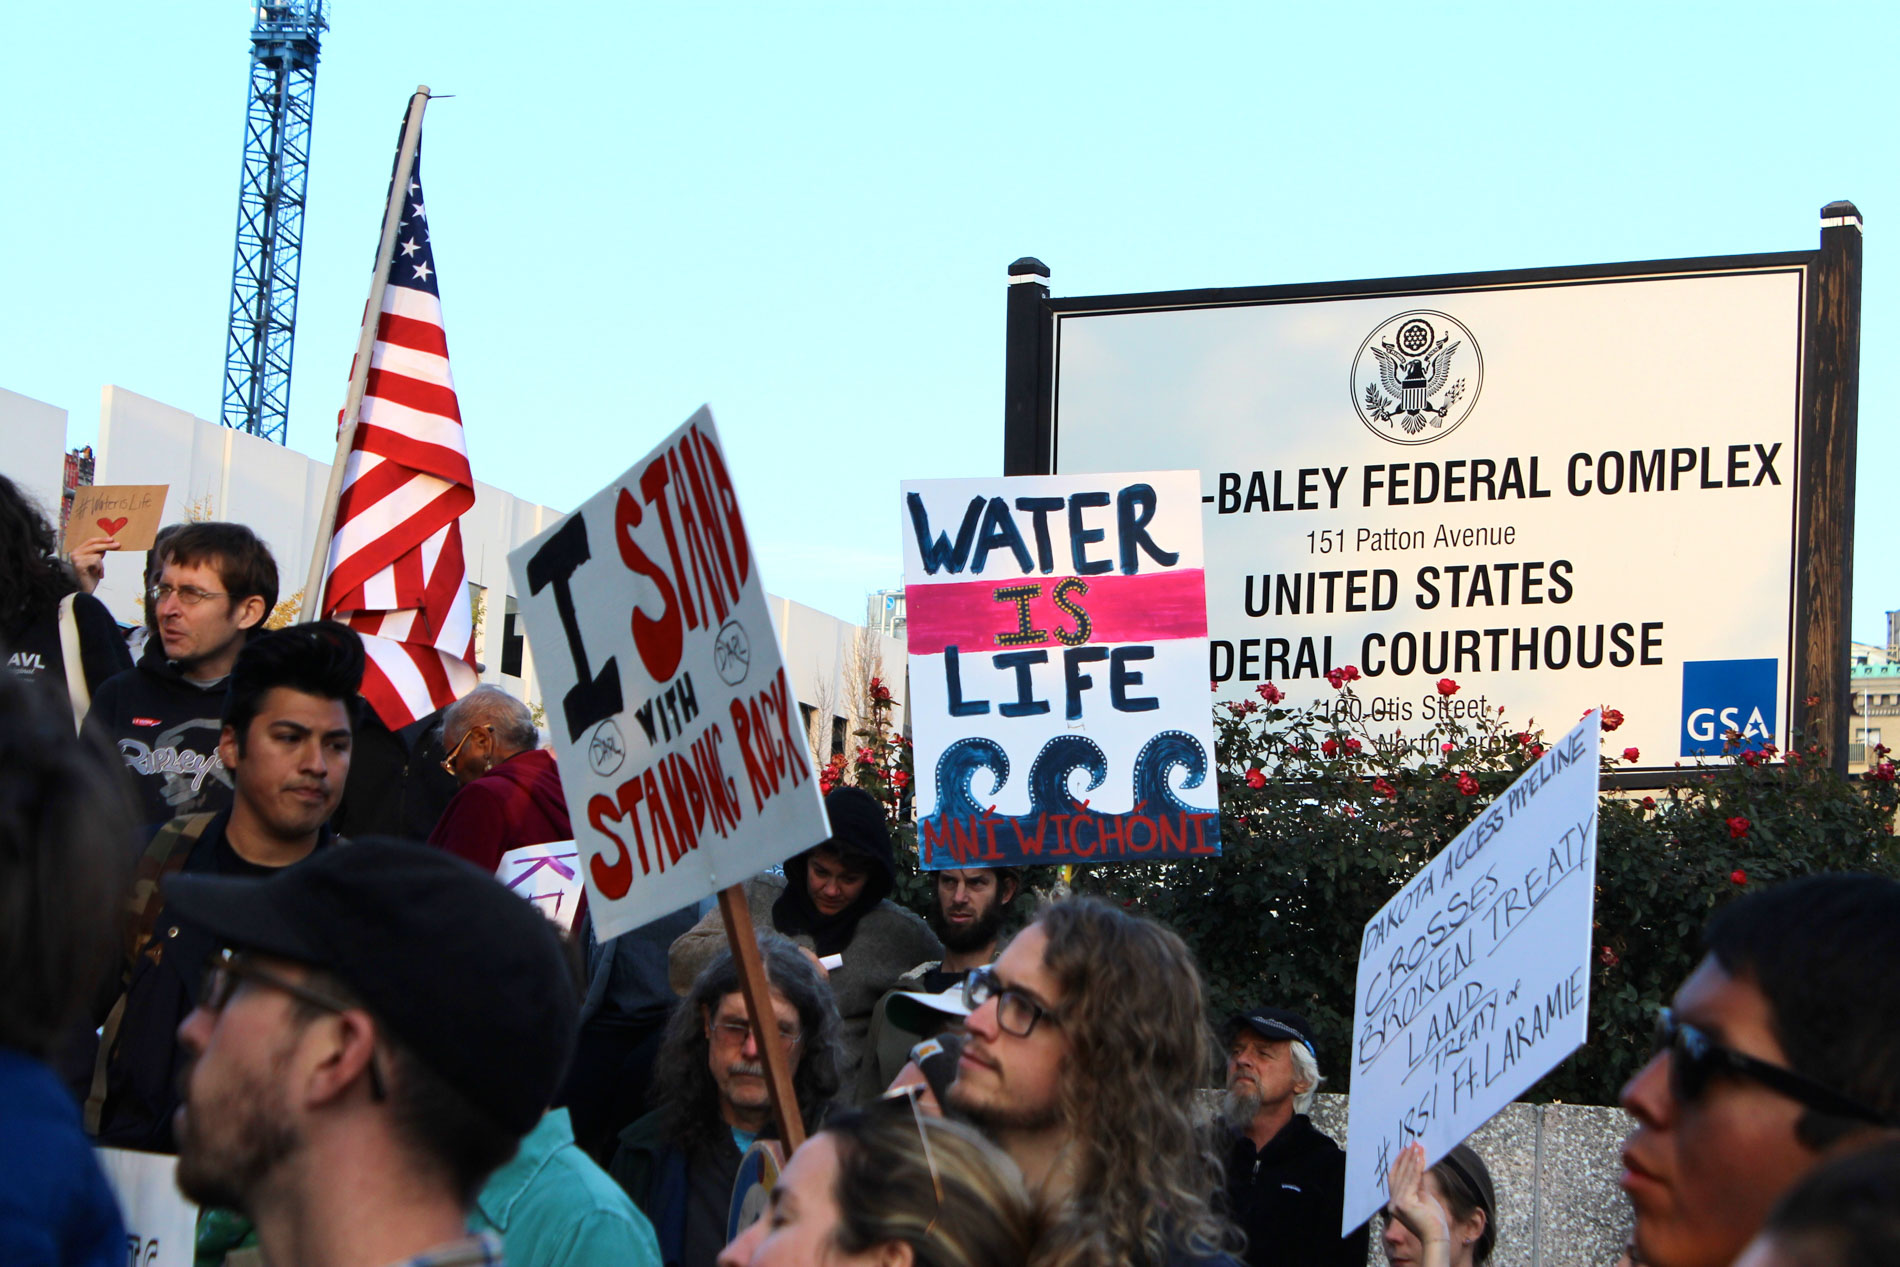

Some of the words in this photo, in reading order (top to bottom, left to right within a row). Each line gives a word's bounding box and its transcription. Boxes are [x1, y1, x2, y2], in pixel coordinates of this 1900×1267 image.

[1363, 456, 1551, 507] FEDERAL
[1567, 443, 1782, 497] COMPLEX
[907, 483, 1179, 575] WATER
[1307, 529, 1345, 554] 151
[1356, 527, 1425, 552] Patton
[1433, 524, 1516, 549] Avenue
[527, 510, 623, 744] I
[615, 422, 749, 683] STAND
[993, 576, 1092, 646] IS
[1244, 568, 1399, 618] UNITED
[1415, 559, 1573, 611] STATES
[7, 652, 46, 669] AVL
[944, 645, 1160, 720] LIFE
[1361, 622, 1664, 677] COURTHOUSE
[634, 671, 699, 747] WITH
[1321, 699, 1362, 723] 100
[1372, 697, 1413, 722] Otis
[1422, 695, 1487, 720] Street
[1686, 706, 1769, 741] GSA
[587, 723, 741, 900] STANDING
[730, 666, 809, 816] ROCK
[1363, 870, 1434, 960] DAKOTA
[1441, 806, 1504, 888] ACCESS
[1507, 728, 1586, 818] PIPELINE
[1359, 928, 1473, 1065] BROKEN
[1482, 812, 1594, 940] TREATY
[1365, 862, 1498, 1016] CROSSES
[1408, 981, 1483, 1068] LAND
[1429, 991, 1498, 1075] TREATY
[1505, 978, 1521, 1006] of
[1452, 1056, 1480, 1115] Ft.
[1485, 966, 1584, 1088] LARAMIE
